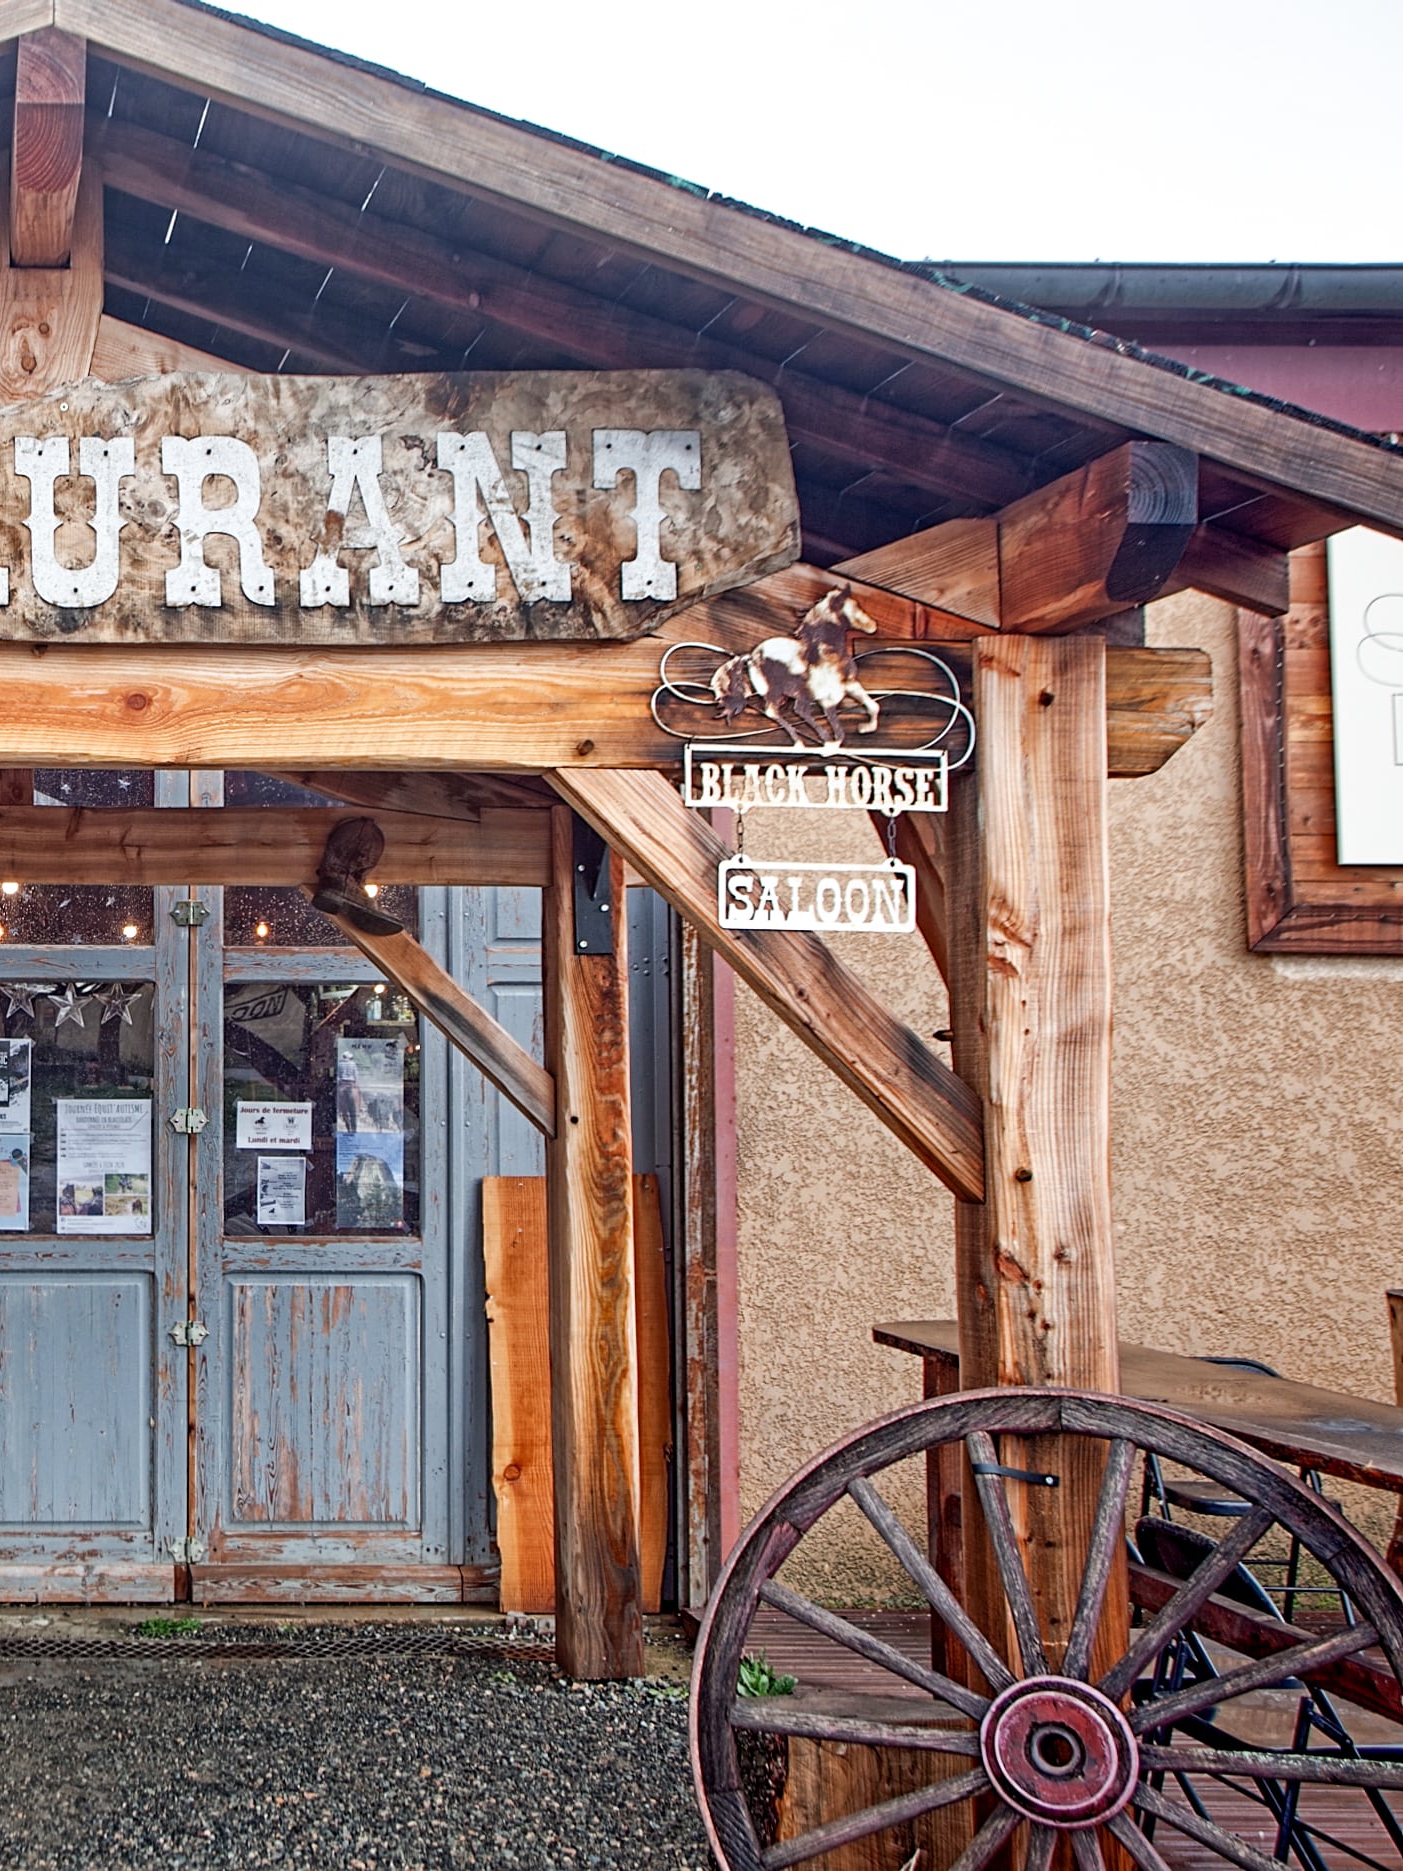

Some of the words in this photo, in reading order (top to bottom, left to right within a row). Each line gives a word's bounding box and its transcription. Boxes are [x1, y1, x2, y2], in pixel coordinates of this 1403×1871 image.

[700, 762, 809, 803] BLACK
[824, 765, 935, 806] HORSE
[727, 875, 905, 924] SALOON
[240, 1106, 260, 1114] Jours
[262, 1106, 270, 1114] de
[273, 1106, 309, 1115] fermeture
[248, 1136, 268, 1144] Lundi
[279, 1136, 301, 1144] mardi
